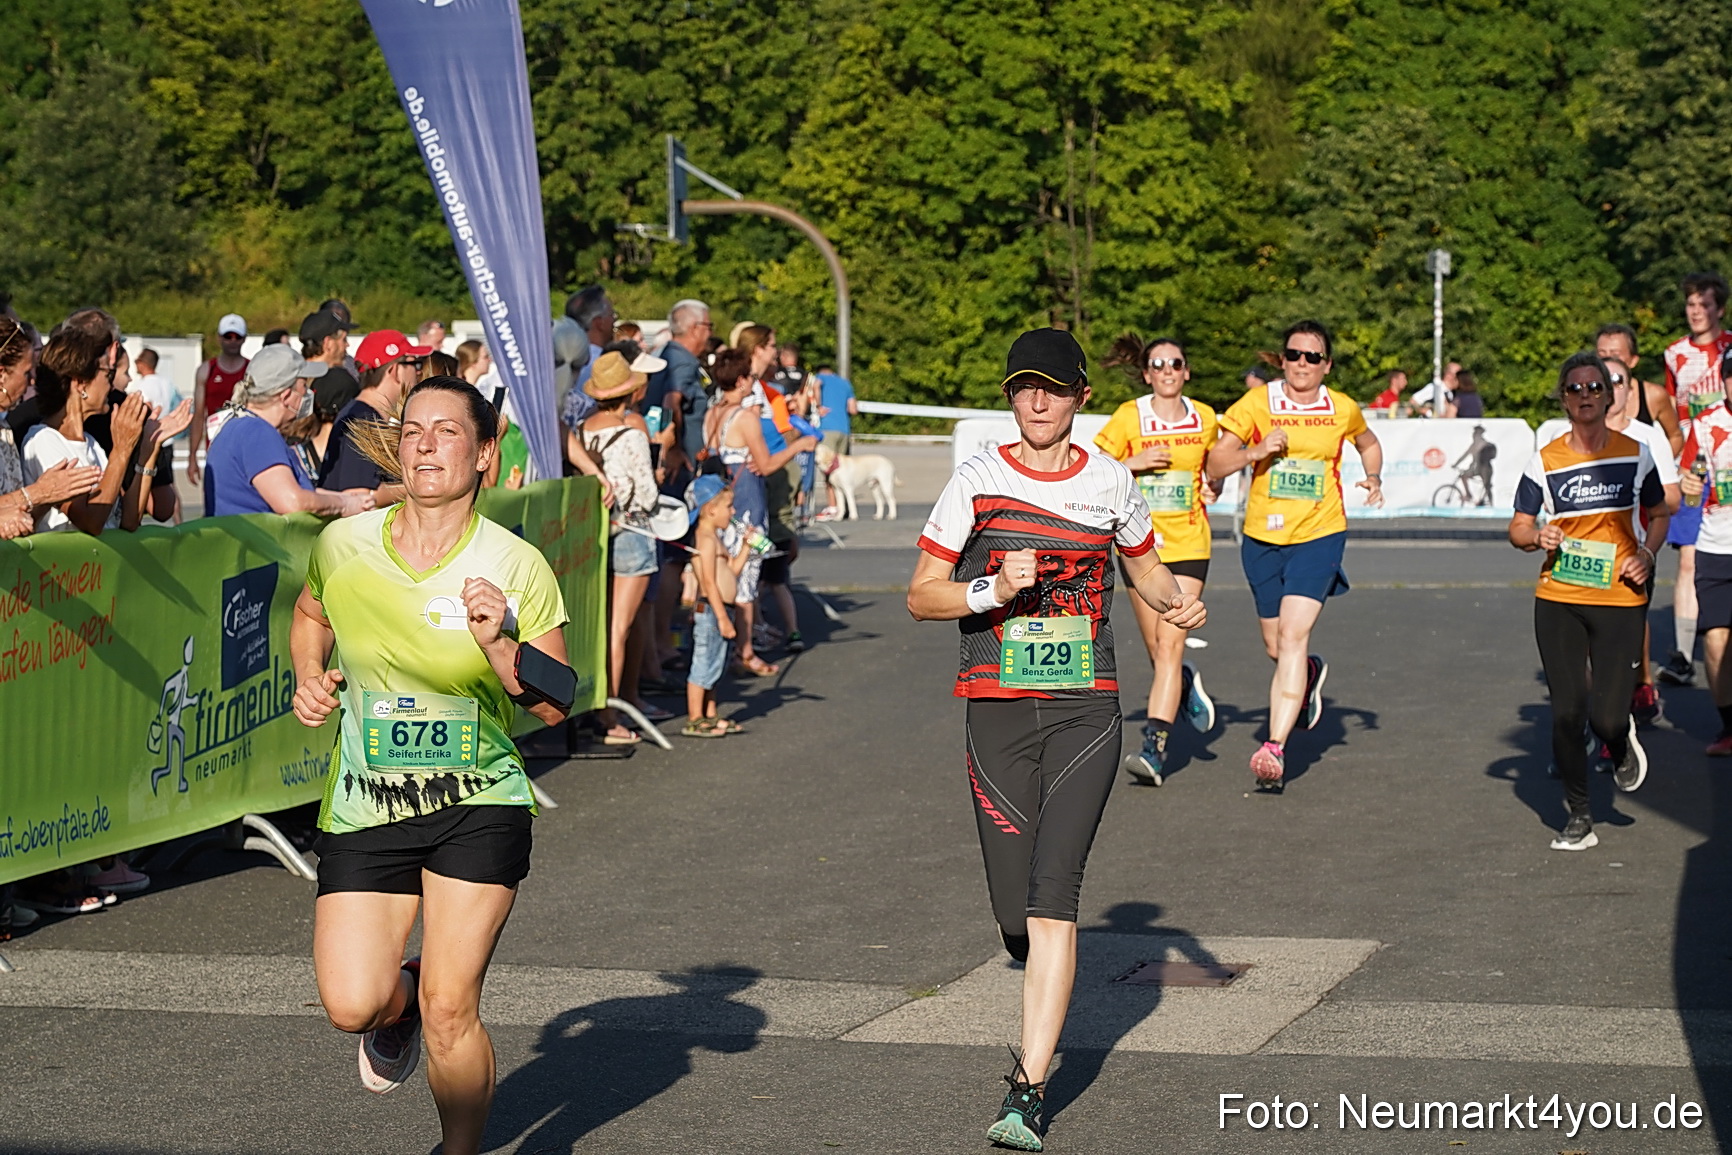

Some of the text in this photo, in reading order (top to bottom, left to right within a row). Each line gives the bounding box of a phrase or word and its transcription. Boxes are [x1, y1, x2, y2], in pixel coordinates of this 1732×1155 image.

[1270, 417, 1337, 427] MAX BÖGL
[1141, 435, 1203, 449] MAX BÖGL
[1149, 485, 1186, 498] 1626
[1279, 472, 1316, 488] 1634
[1569, 475, 1624, 498] Fischer
[1574, 493, 1619, 504] AUTOMOBILE
[1562, 553, 1604, 573] 1835
[39, 562, 102, 609] Firmen
[0, 596, 115, 683] ufen länger!
[1005, 648, 1014, 674] RUN
[1024, 642, 1072, 666] 129
[1080, 644, 1091, 678] 2022
[1022, 667, 1074, 676] Benz Gerda
[392, 706, 428, 715] Firmenlauf
[369, 728, 379, 756] RUN
[391, 720, 449, 747] 678
[461, 724, 472, 761] 2022
[195, 736, 252, 782] neumarkt
[387, 748, 452, 759] Seifert Erika
